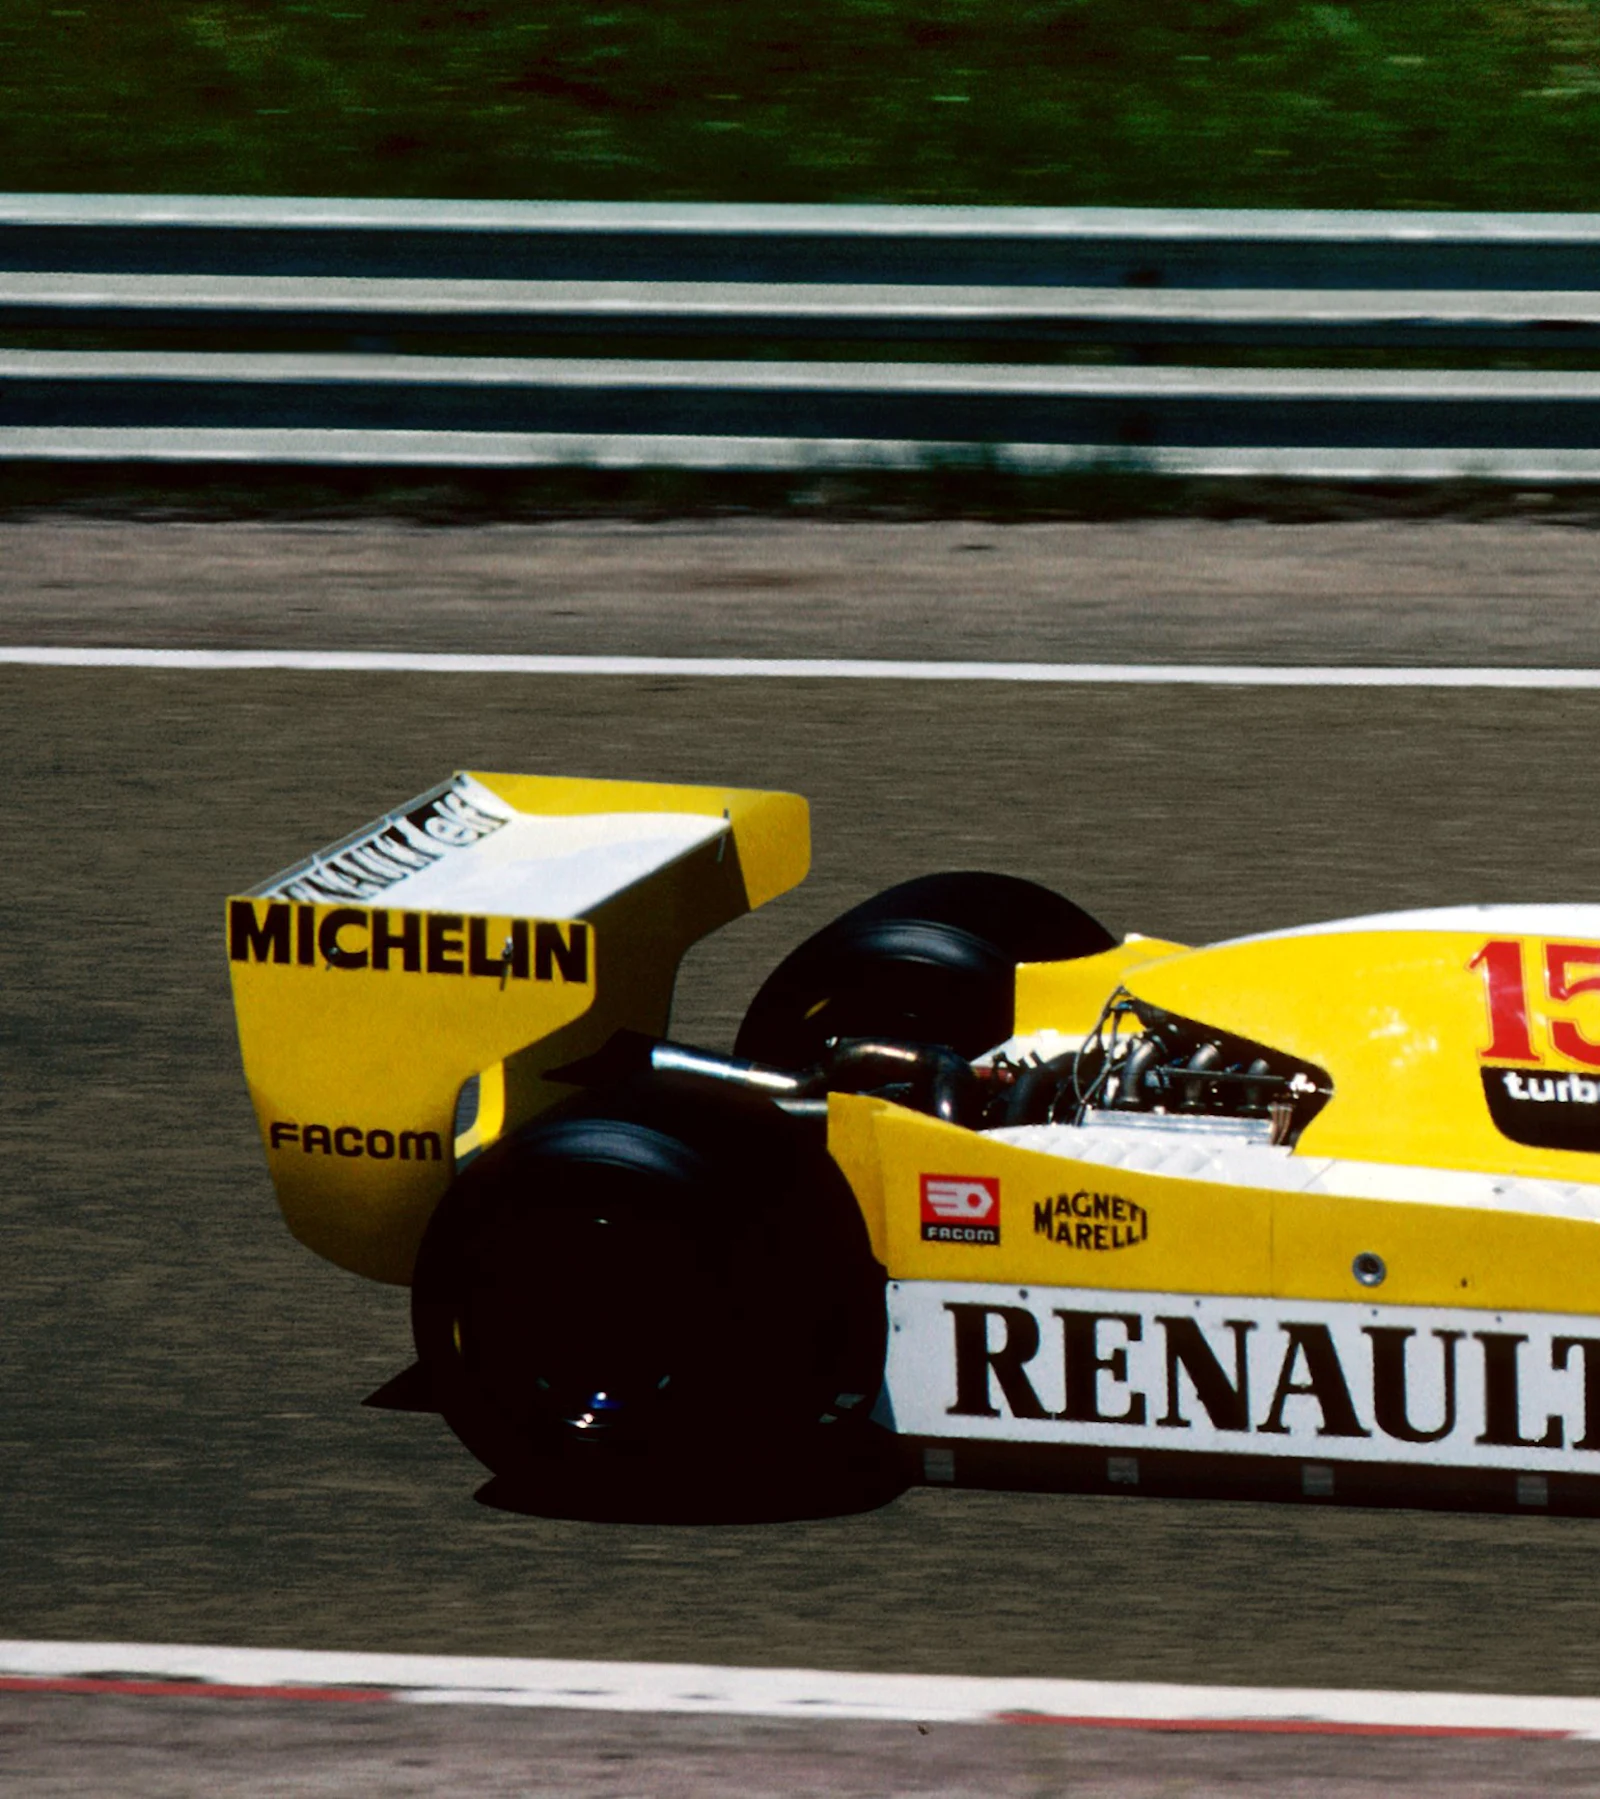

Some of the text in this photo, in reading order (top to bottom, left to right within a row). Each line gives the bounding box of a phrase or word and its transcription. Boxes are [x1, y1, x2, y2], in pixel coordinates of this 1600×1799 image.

[424, 791, 503, 847] elf
[229, 900, 588, 983] MICHELIN
[1034, 1190, 1148, 1232] MAGNETI
[1034, 1207, 1148, 1251] MARELLI
